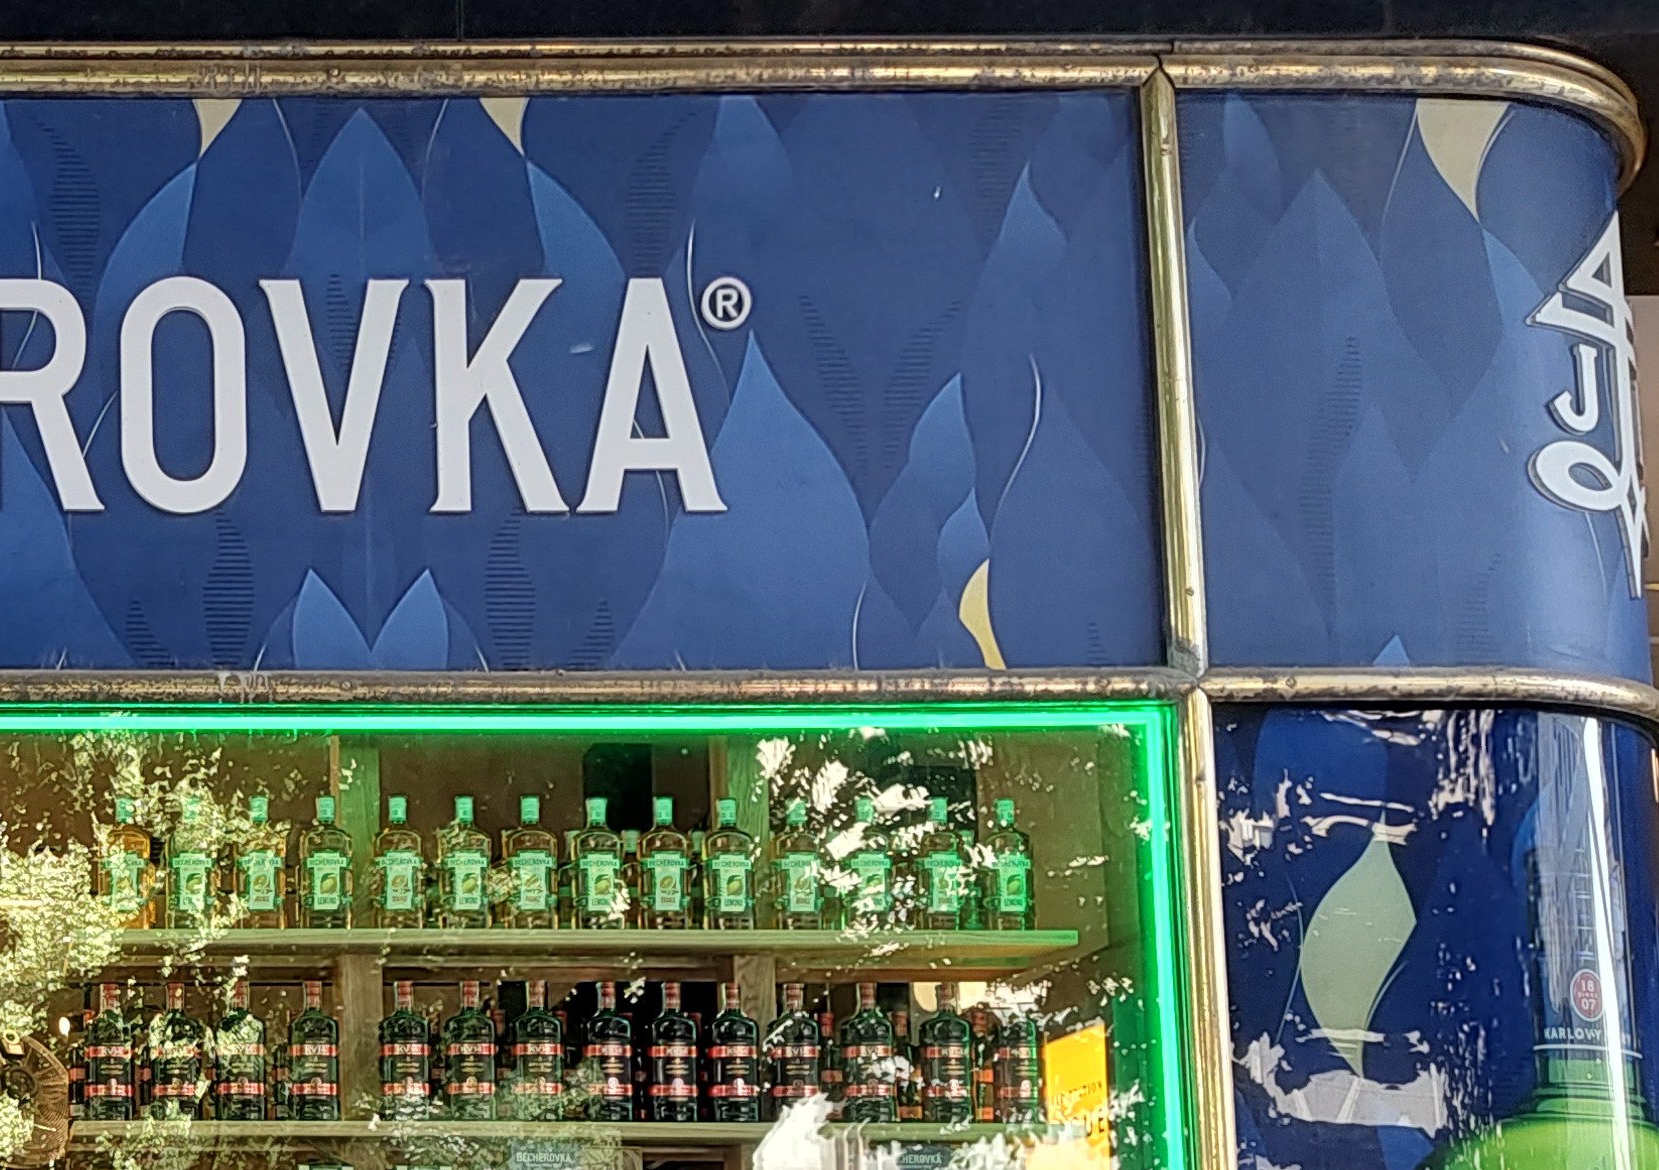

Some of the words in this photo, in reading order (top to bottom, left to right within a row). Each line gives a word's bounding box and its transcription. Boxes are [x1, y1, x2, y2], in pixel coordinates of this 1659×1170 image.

[1580, 980, 1595, 992] 18
[1581, 998, 1597, 1010] 07
[1544, 1027, 1602, 1041] KARLOVY
[516, 1152, 572, 1163] BECHEROVKA
